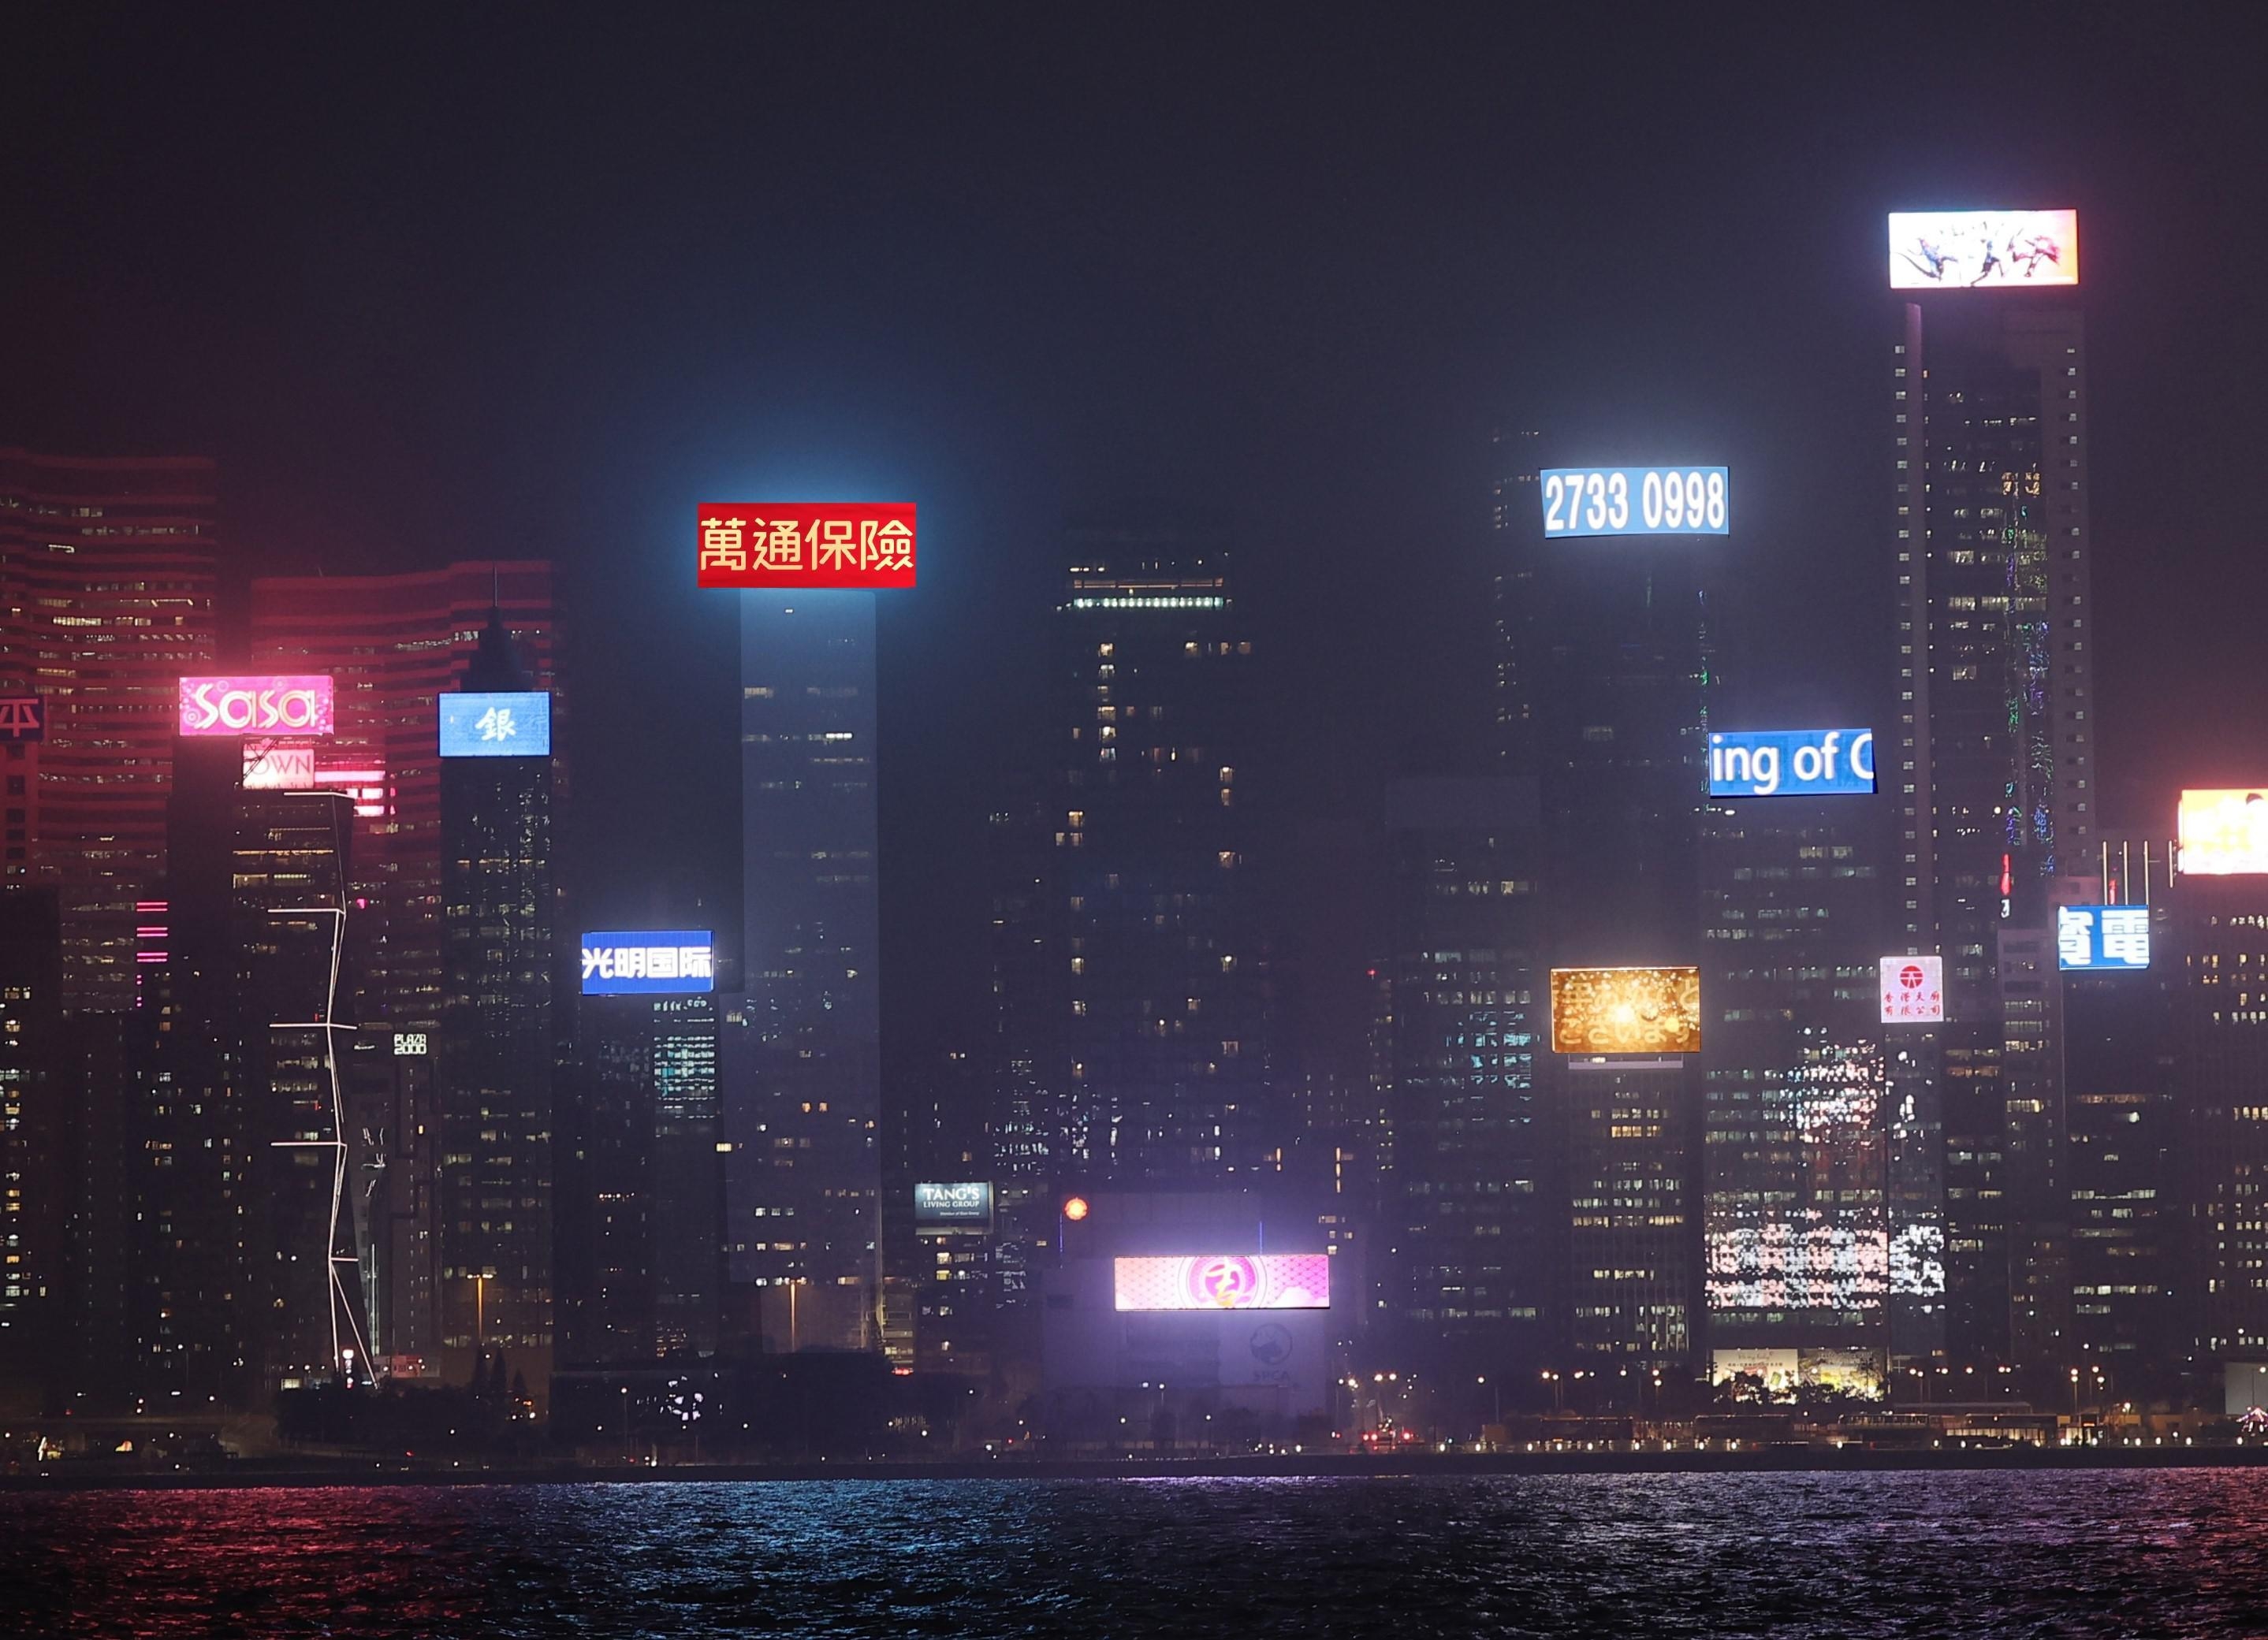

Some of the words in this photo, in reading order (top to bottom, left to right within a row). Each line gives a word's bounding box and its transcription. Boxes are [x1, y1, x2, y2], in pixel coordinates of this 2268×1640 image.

[1546, 473, 1629, 530] 2733
[1643, 471, 1725, 529] 0998
[701, 518, 914, 571] 萬通保險
[475, 707, 517, 742] 銀
[1793, 731, 1840, 781] of
[582, 947, 712, 980] 光明国际
[394, 1033, 426, 1044] PLAZA
[394, 1043, 426, 1055] 2000
[922, 1186, 980, 1200] TANG'S
